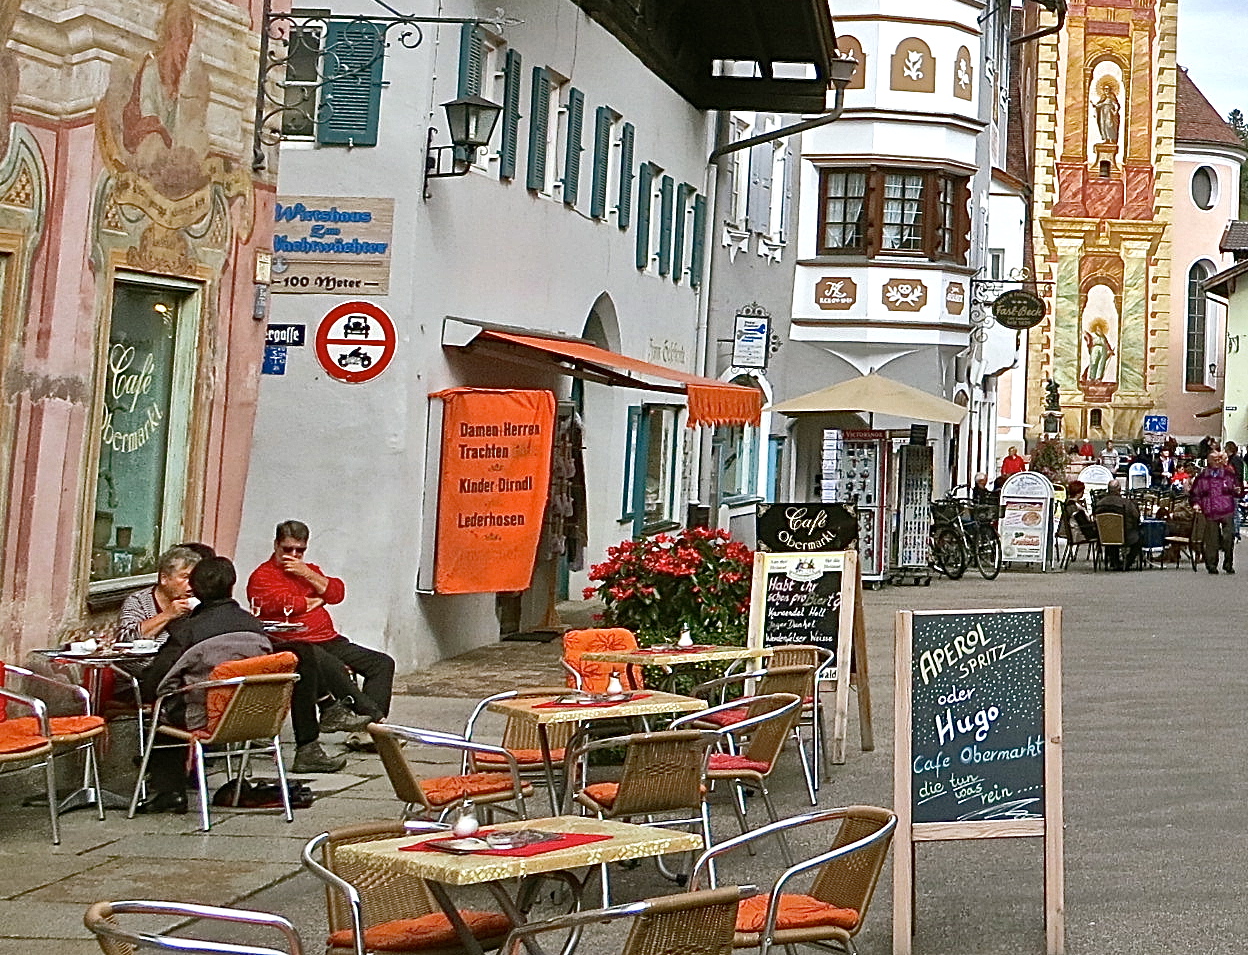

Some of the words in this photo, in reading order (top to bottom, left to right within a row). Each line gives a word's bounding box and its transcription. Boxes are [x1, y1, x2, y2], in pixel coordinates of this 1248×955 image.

[275, 203, 372, 223] Wirtshaus
[284, 277, 310, 287] 100
[315, 276, 361, 290] Meter
[110, 344, 155, 413] Café
[460, 422, 499, 438] Damen
[503, 422, 540, 437] Herren
[458, 443, 509, 459] Trachten
[459, 478, 495, 493] Kinder
[498, 476, 533, 492] Dirndl
[458, 512, 525, 528] Lederhosen
[785, 507, 828, 536] Café
[778, 530, 837, 550] Obermarkt
[768, 576, 795, 592] Habt
[800, 580, 819, 593] ihr
[919, 623, 992, 685] APEROL
[959, 642, 1022, 679] SPRITZ
[938, 685, 976, 706] oder
[935, 705, 999, 746] Hugo
[913, 751, 951, 778] Cafe
[960, 735, 1045, 765] Obermarkt
[919, 780, 945, 798] die
[950, 773, 979, 788] tun
[955, 784, 983, 799] was
